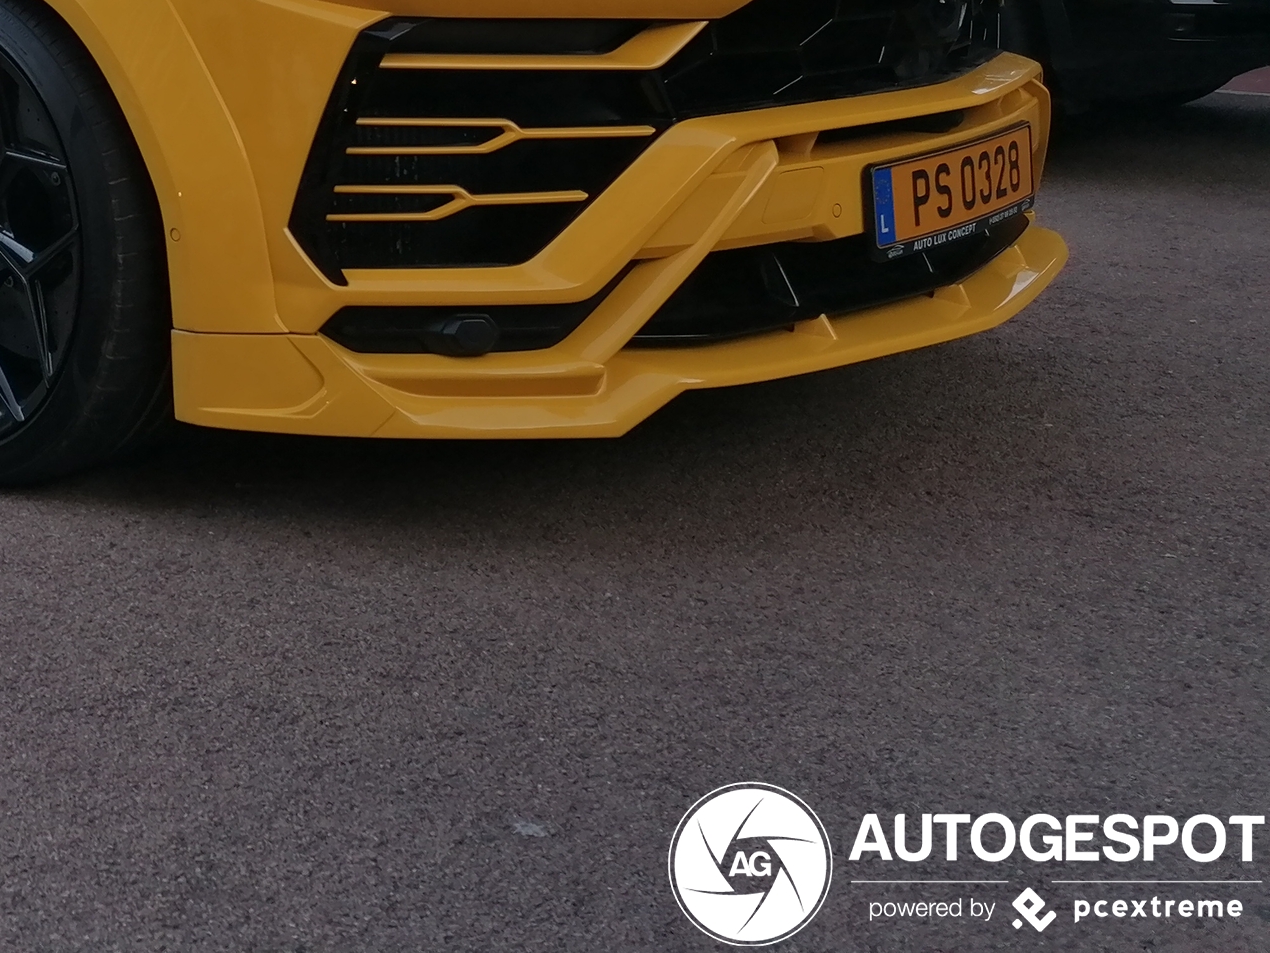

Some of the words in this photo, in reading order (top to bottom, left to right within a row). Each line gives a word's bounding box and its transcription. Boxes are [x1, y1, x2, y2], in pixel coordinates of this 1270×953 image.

[911, 162, 953, 227] PS
[960, 140, 1021, 211] 0328
[880, 214, 889, 234] L
[913, 237, 932, 251] AUTO
[933, 232, 947, 245] LUX
[947, 222, 977, 241] CONCEPT
